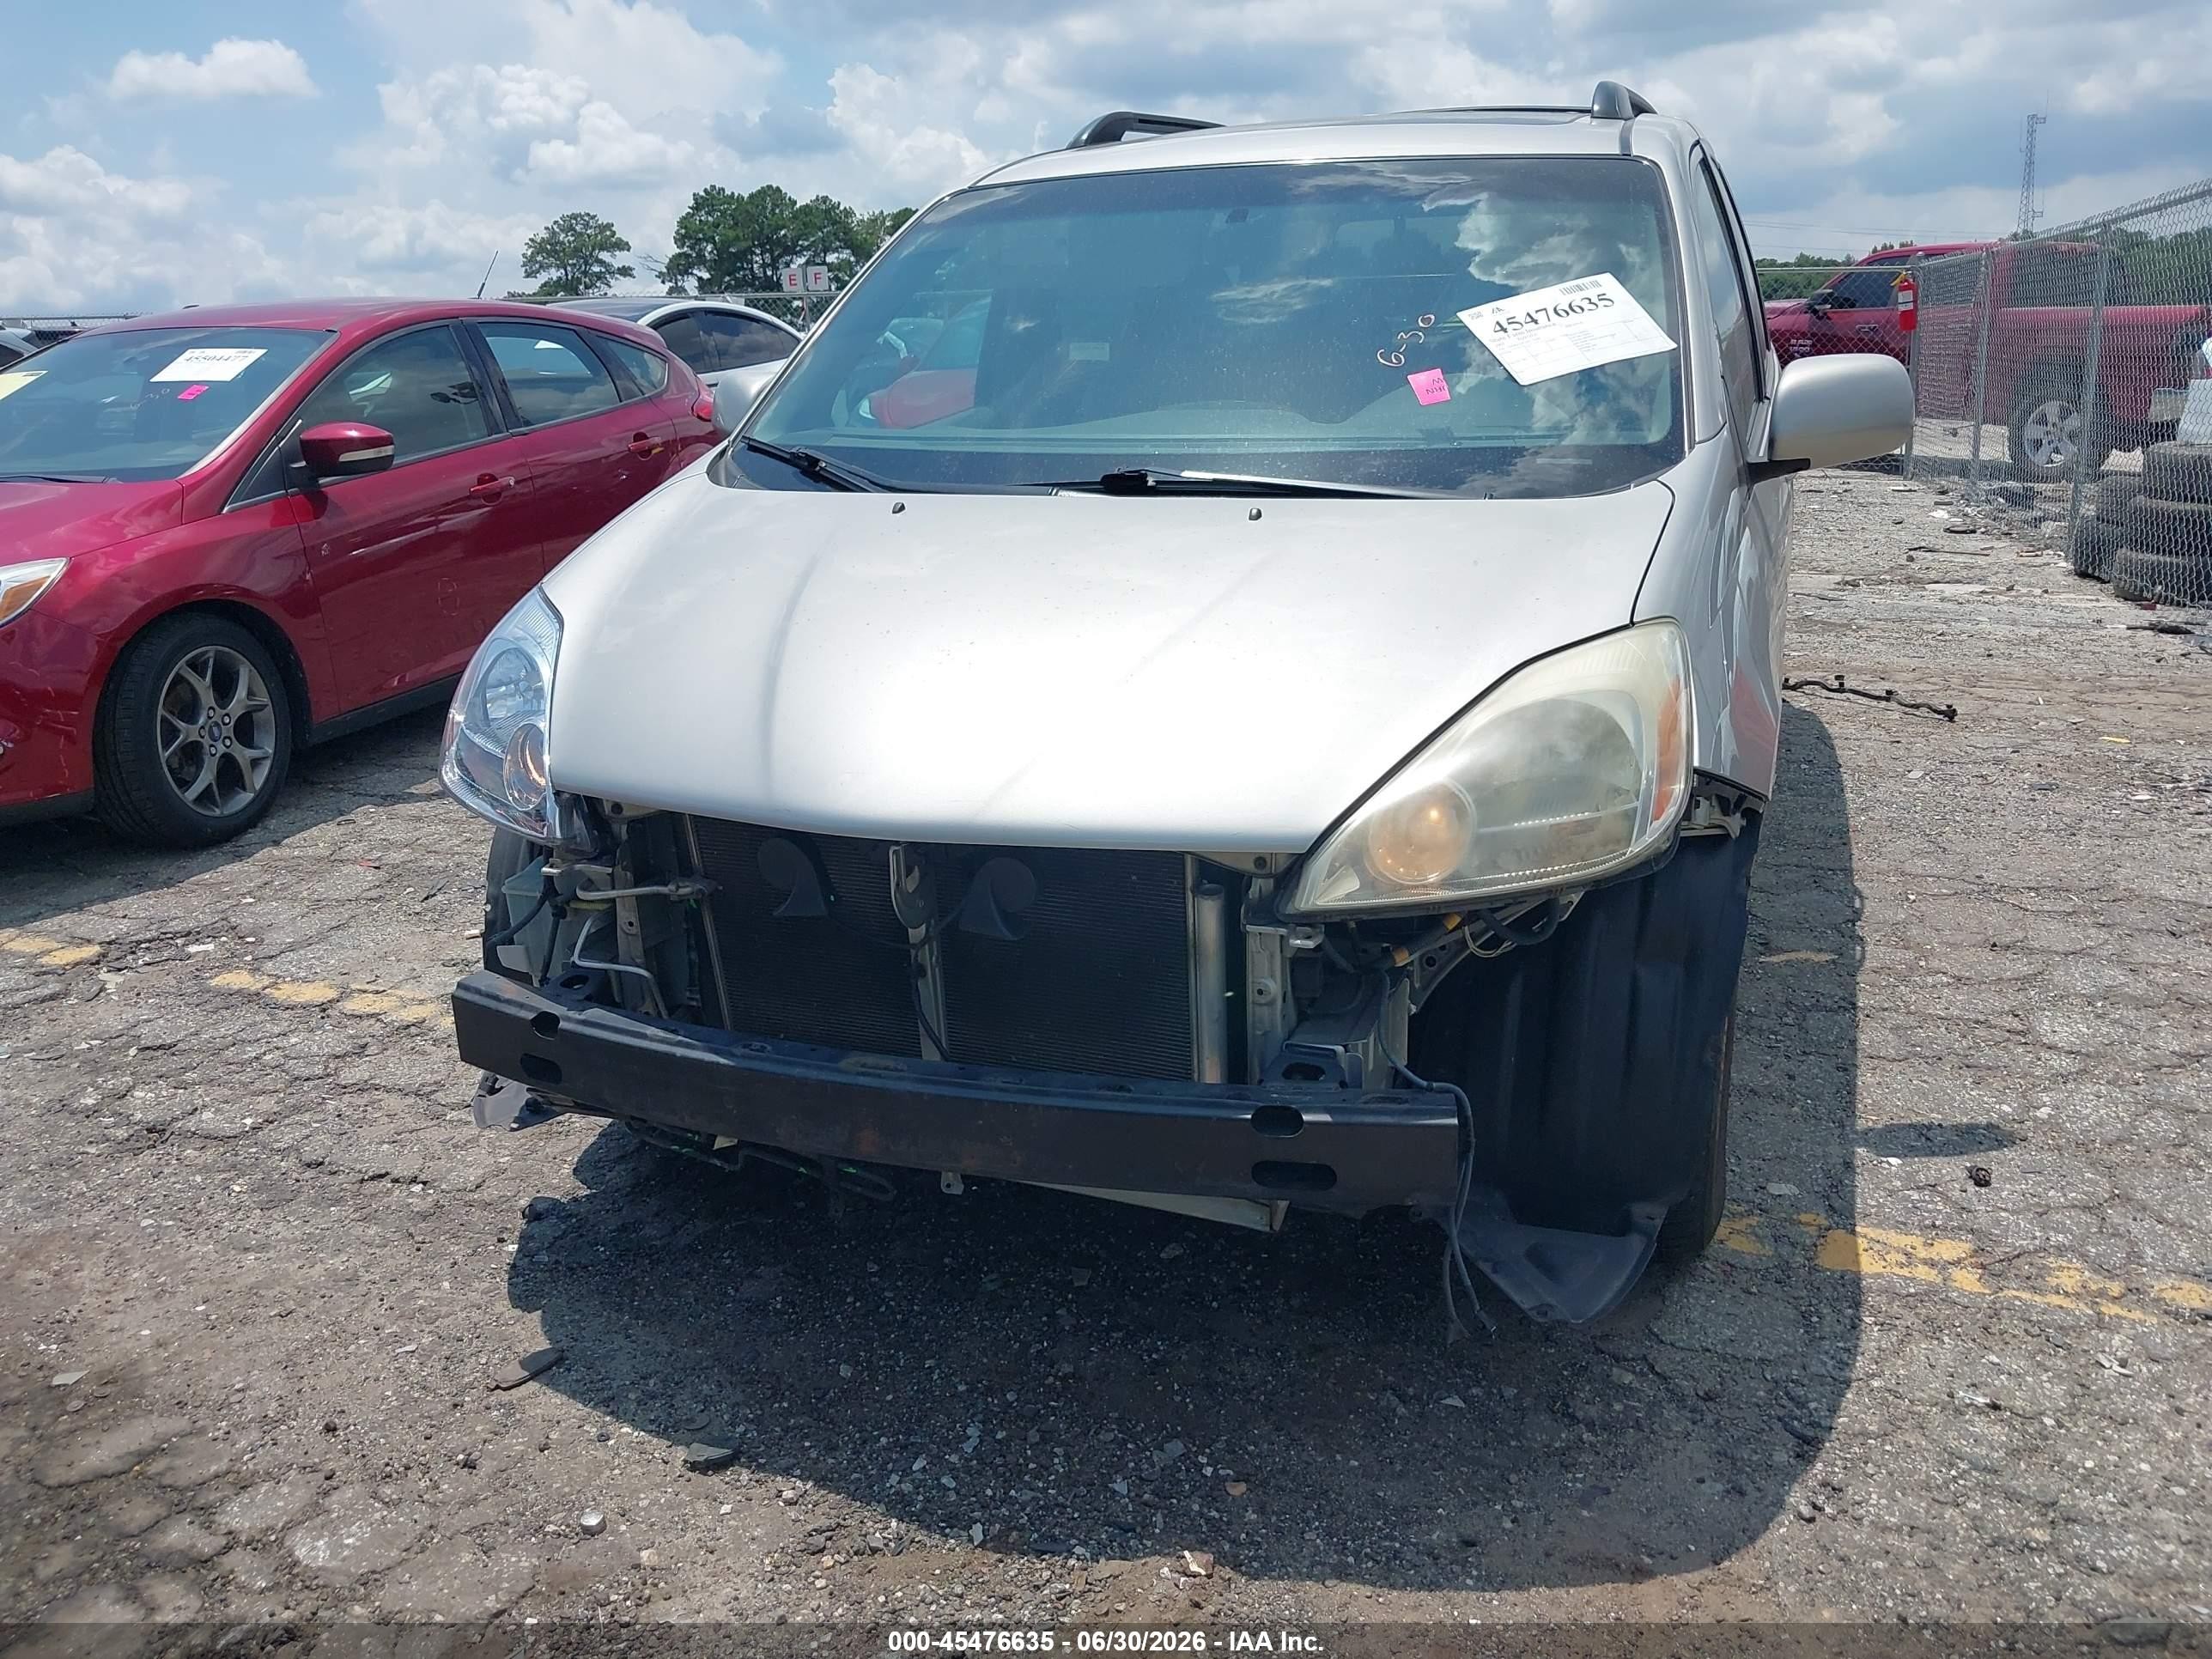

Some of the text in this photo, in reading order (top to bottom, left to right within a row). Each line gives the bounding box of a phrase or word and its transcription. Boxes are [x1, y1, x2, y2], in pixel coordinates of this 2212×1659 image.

[788, 274, 797, 287] E
[813, 272, 822, 285] F
[1492, 293, 1615, 335] 45476635
[1376, 313, 1436, 368] 6-30
